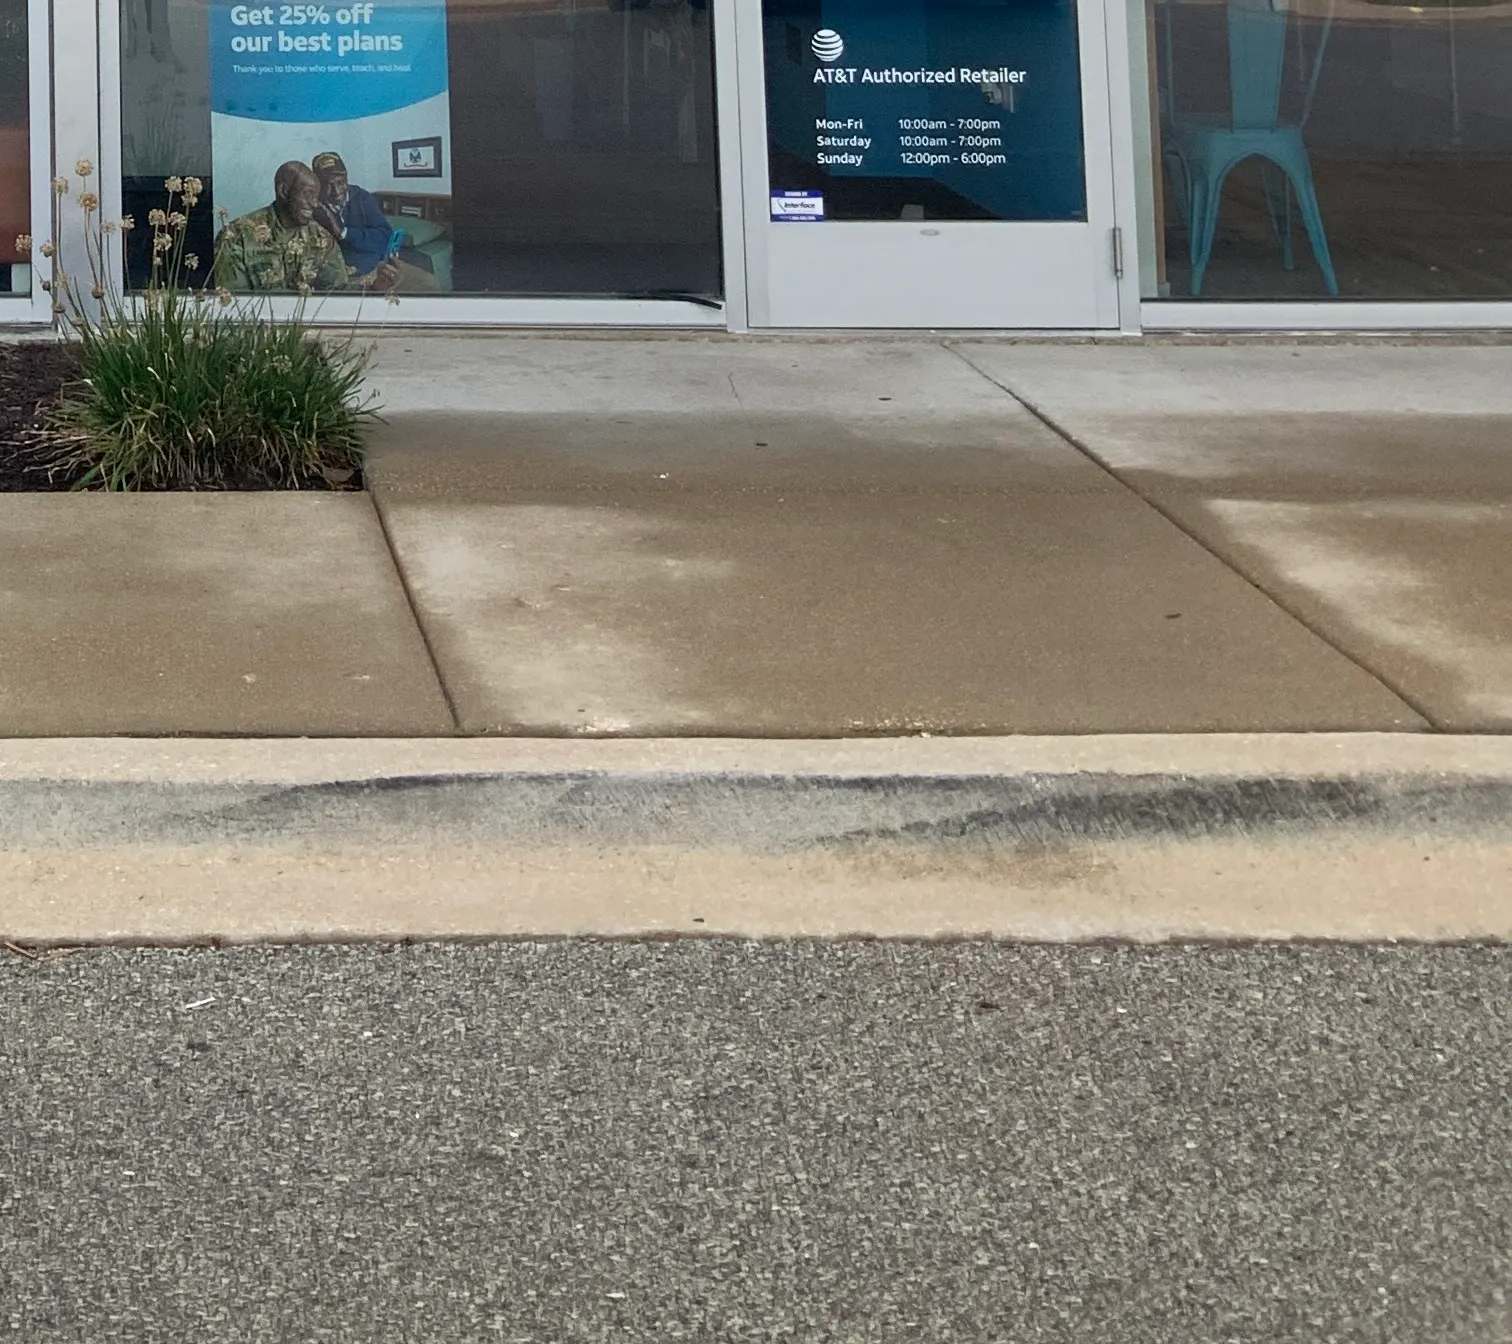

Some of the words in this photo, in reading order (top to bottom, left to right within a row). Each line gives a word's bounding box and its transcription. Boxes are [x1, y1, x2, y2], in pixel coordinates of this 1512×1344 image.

[230, 5, 274, 26] Get
[279, 4, 331, 26] 25%
[335, 2, 374, 25] off
[231, 35, 273, 52] our
[277, 30, 332, 52] best
[337, 29, 403, 57] plans
[232, 64, 258, 73] Thank
[258, 66, 273, 75] you
[274, 65, 284, 73] to
[285, 64, 308, 73] those
[308, 64, 325, 73] who
[813, 68, 857, 84] AT&T
[861, 67, 956, 84] Authorized
[960, 67, 1027, 84] Retailer
[815, 118, 863, 129] Mon-Fri
[898, 118, 947, 129] 10:00am
[957, 118, 1001, 131] 7:00pm
[816, 135, 872, 150] Saturday
[899, 135, 948, 147] 10:00am
[958, 135, 1002, 148] 7:00pm
[816, 152, 863, 167] Sunday
[900, 152, 951, 167] 12:00pm
[961, 152, 1006, 167] 6:00pm
